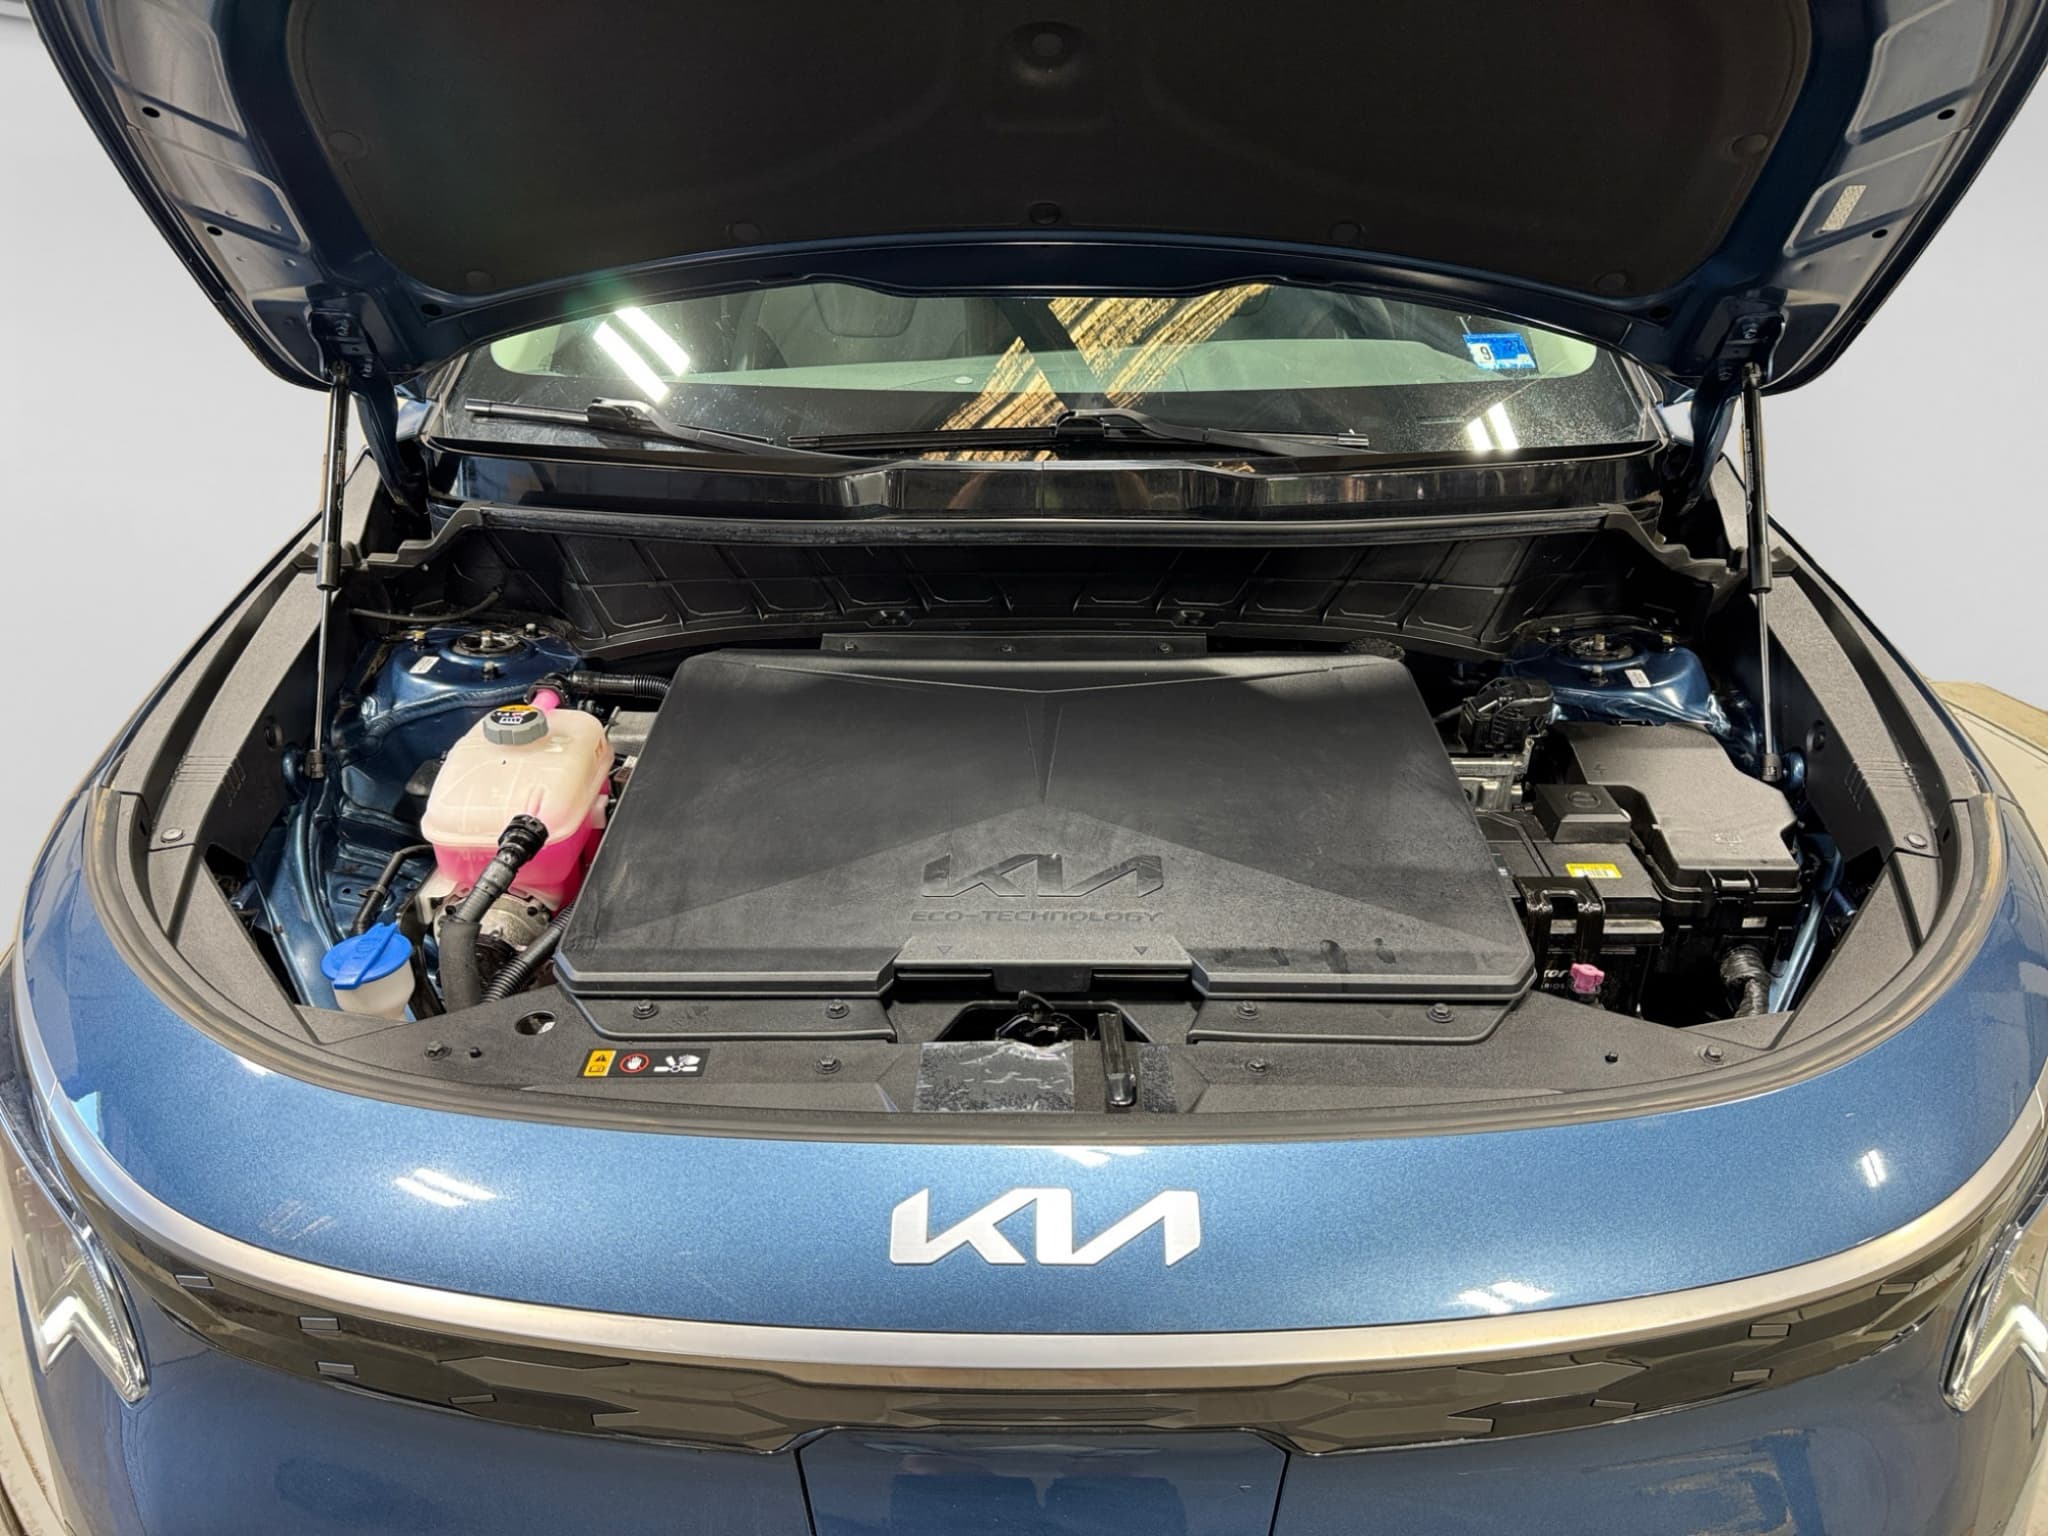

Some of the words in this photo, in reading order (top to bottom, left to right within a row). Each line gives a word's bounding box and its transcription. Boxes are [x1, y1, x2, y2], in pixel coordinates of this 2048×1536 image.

[1480, 345, 1492, 361] 9
[922, 852, 1164, 898] KIA
[911, 909, 1166, 923] ECO-TECHNOLOGY
[889, 1187, 1202, 1267] KIA
